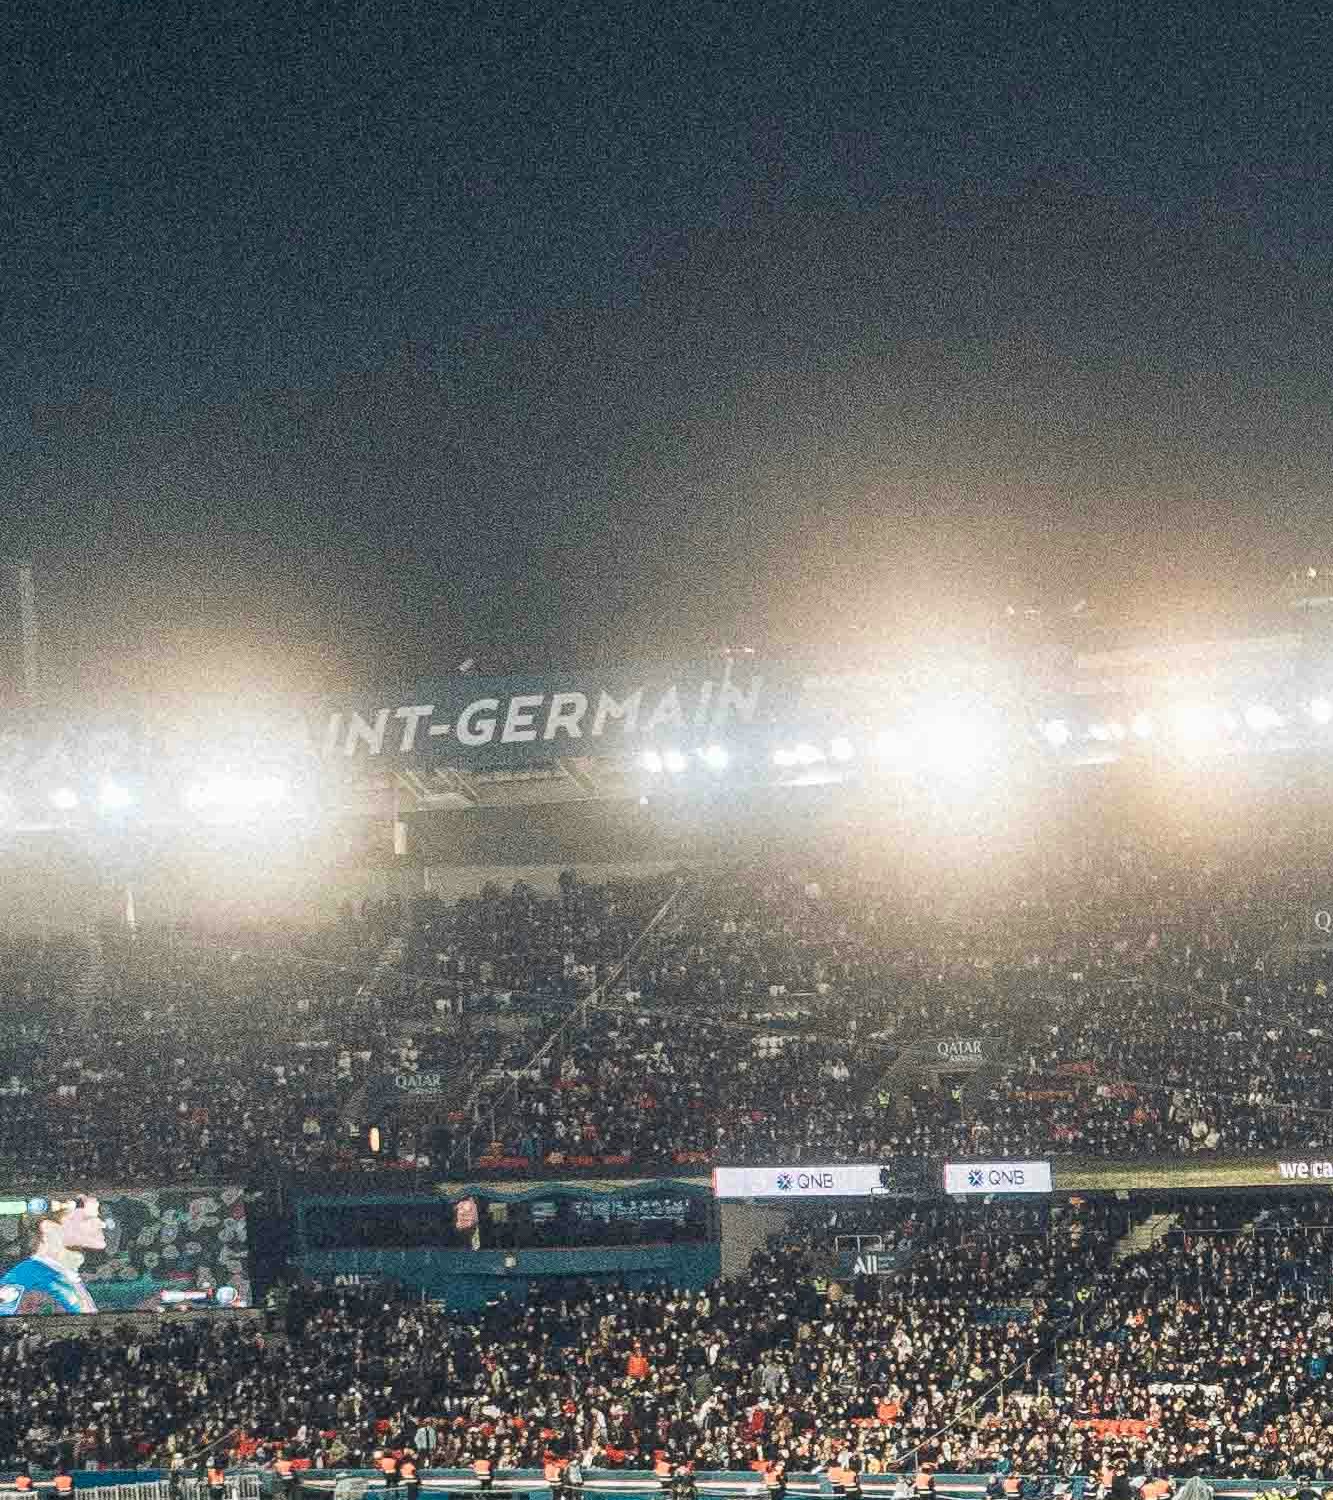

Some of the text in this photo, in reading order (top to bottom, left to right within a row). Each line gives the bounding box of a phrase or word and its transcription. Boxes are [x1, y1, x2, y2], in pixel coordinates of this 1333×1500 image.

[325, 677, 763, 758] INT-GERMAIN
[988, 1169, 1025, 1186] QNB
[1279, 1159, 1309, 1179] we
[796, 1173, 834, 1189] QNB
